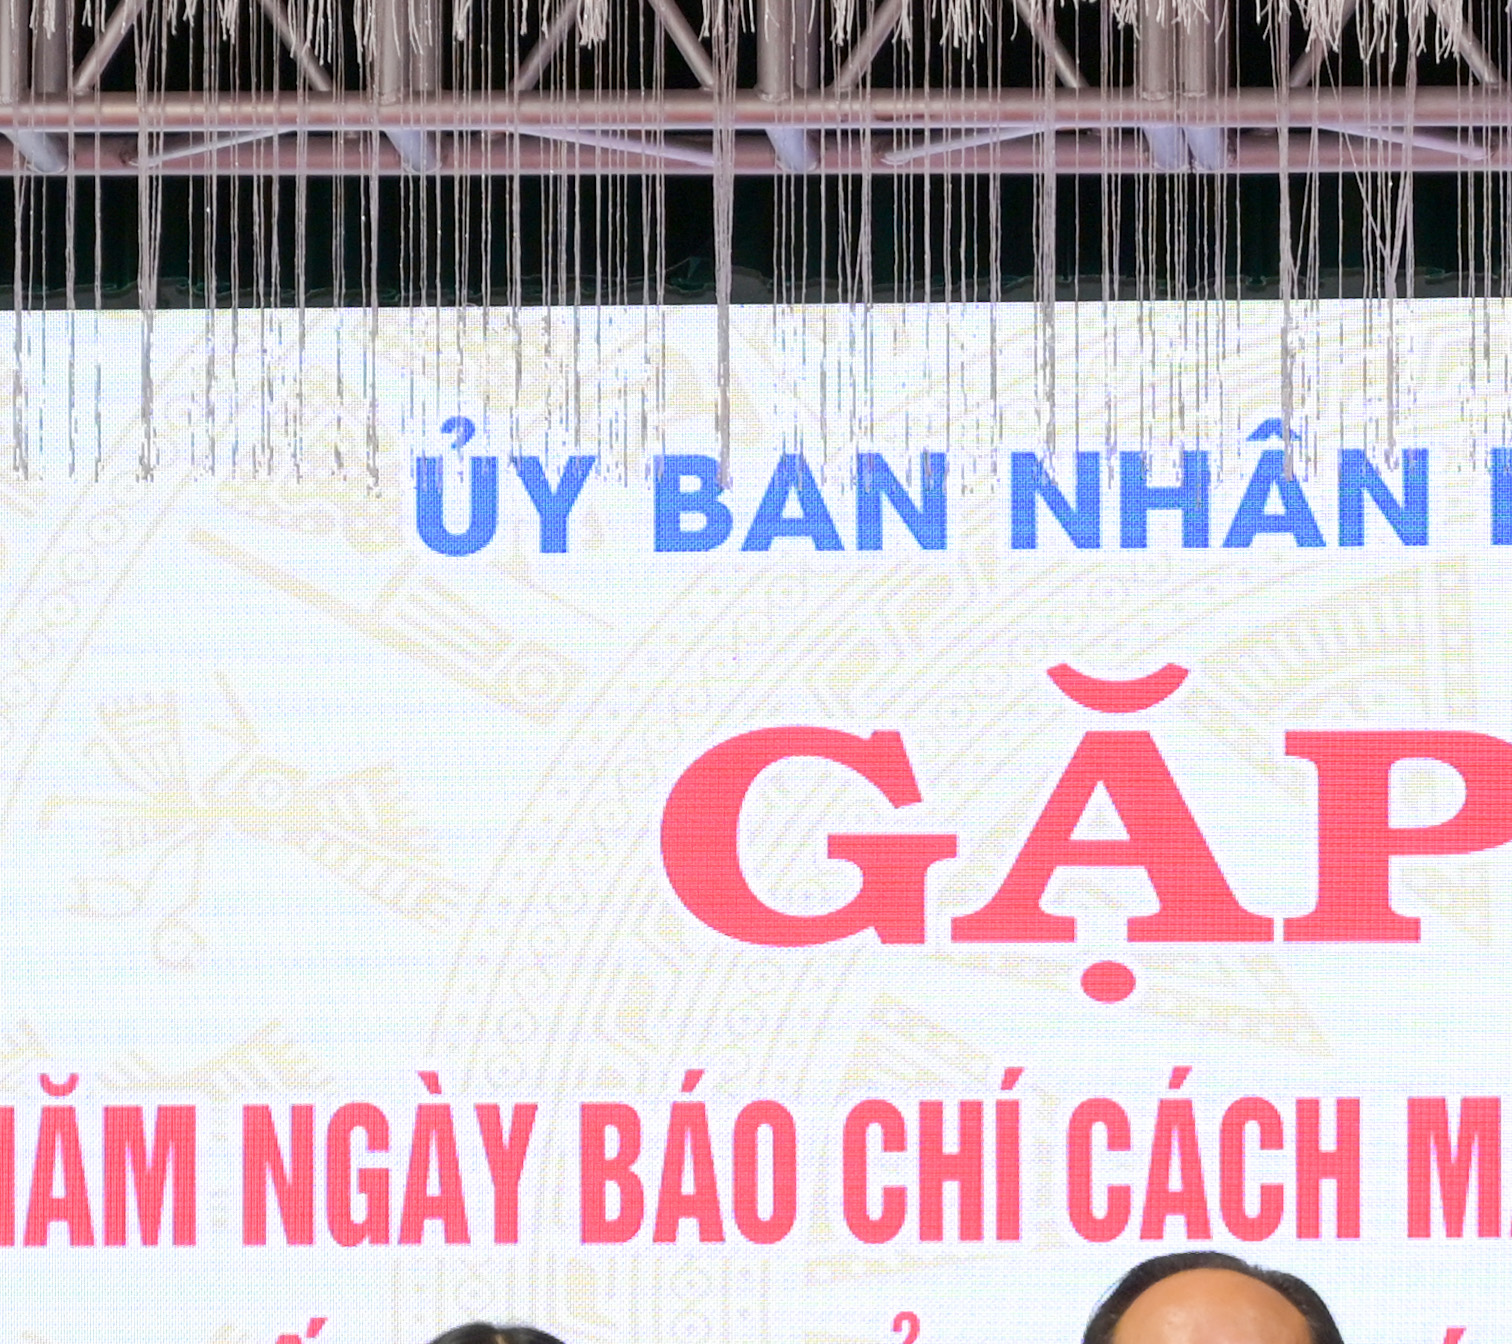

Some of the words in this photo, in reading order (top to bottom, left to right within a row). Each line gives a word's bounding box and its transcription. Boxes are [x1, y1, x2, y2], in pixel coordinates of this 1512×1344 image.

[413, 415, 598, 558] ỦY
[652, 449, 949, 553] BAN
[1009, 417, 1431, 549] NHÂN
[241, 1070, 539, 1247] NGÀY
[579, 1068, 798, 1245] BÁO
[841, 1066, 1022, 1244] CHÍ
[1066, 1065, 1361, 1243] CÁCH
